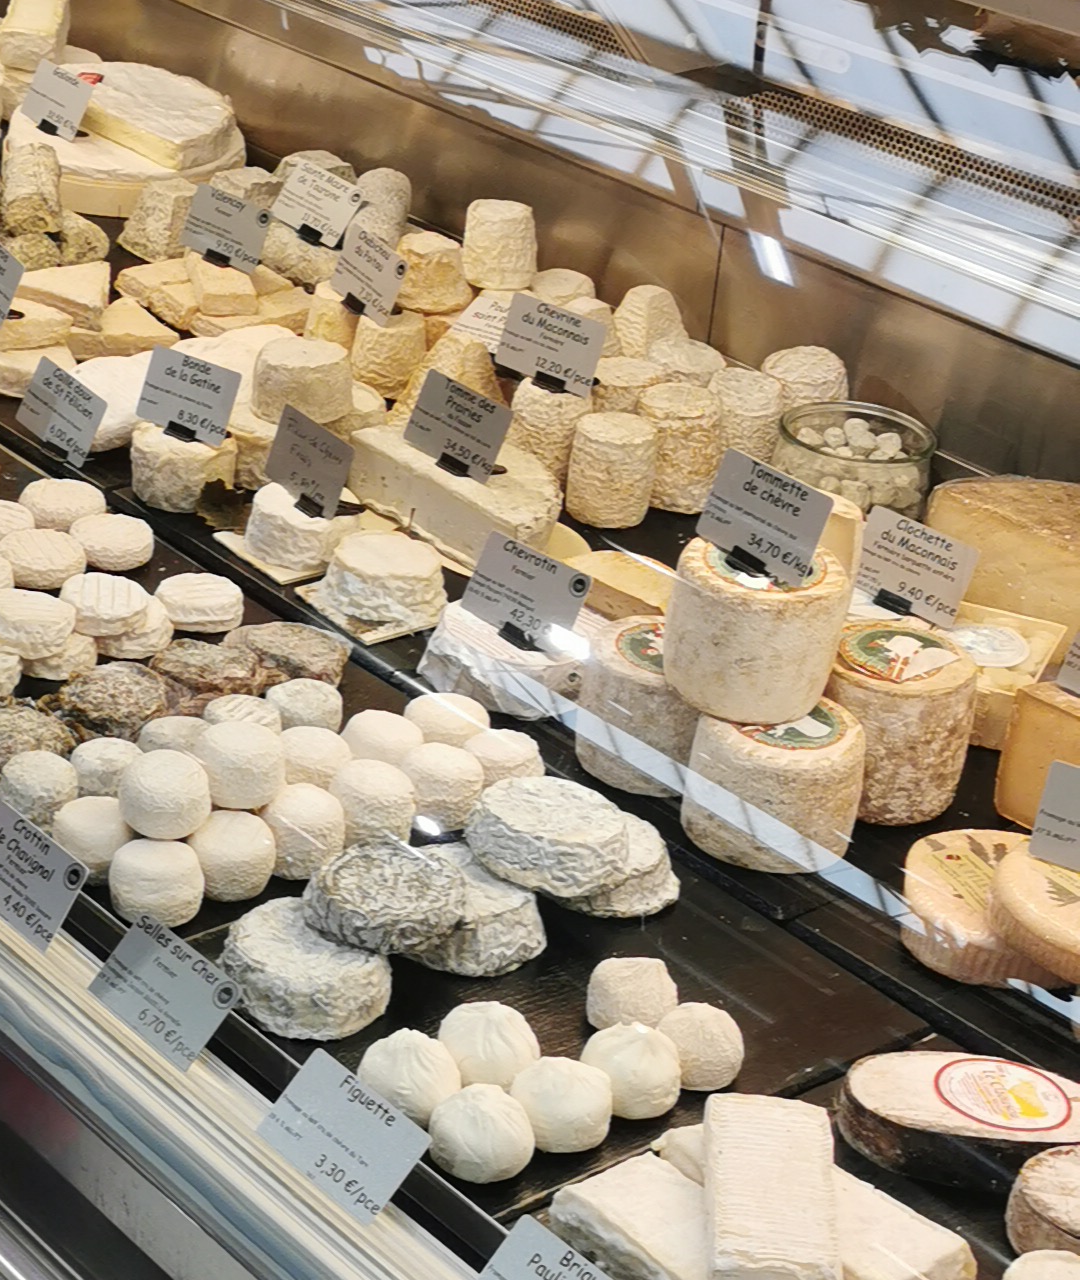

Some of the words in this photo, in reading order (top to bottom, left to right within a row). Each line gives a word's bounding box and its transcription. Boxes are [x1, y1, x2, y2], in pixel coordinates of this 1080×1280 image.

[521, 311, 534, 326] du
[536, 302, 582, 328] Chevrine
[164, 365, 177, 378] de
[178, 369, 188, 382] la
[181, 355, 212, 376] Bonde
[535, 355, 562, 375] 12,20
[563, 367, 593, 387] €/pce
[445, 378, 476, 405] Tomme
[478, 396, 497, 415] des
[445, 395, 484, 424] Prairies
[177, 409, 198, 426] 8,30
[199, 416, 227, 437] €/pce
[443, 437, 470, 461] 34,50
[470, 454, 493, 476] €/kg
[742, 479, 759, 496] de
[760, 488, 801, 517] chèvre
[750, 460, 809, 502] Tommette
[880, 529, 896, 544] du
[896, 535, 958, 571] Maconnais
[896, 518, 954, 552] Clochette
[503, 540, 558, 575] Chevrotin
[746, 532, 781, 559] 34,70
[782, 551, 808, 578] €/kg
[897, 581, 924, 601] 9,40
[924, 594, 958, 617] €/pce
[13, 818, 51, 856] Crottin
[6, 837, 57, 883] Chavignol
[2, 893, 27, 918] 4,40
[25, 912, 54, 943] €/pce
[136, 915, 173, 949] Selles
[170, 944, 193, 963] sur
[191, 958, 220, 986] Cher
[137, 1007, 166, 1035] 6,70
[164, 1028, 197, 1062] €/pce
[338, 1074, 397, 1128] Figuette
[314, 1153, 346, 1184] 3,30
[344, 1178, 381, 1216] €/pce
